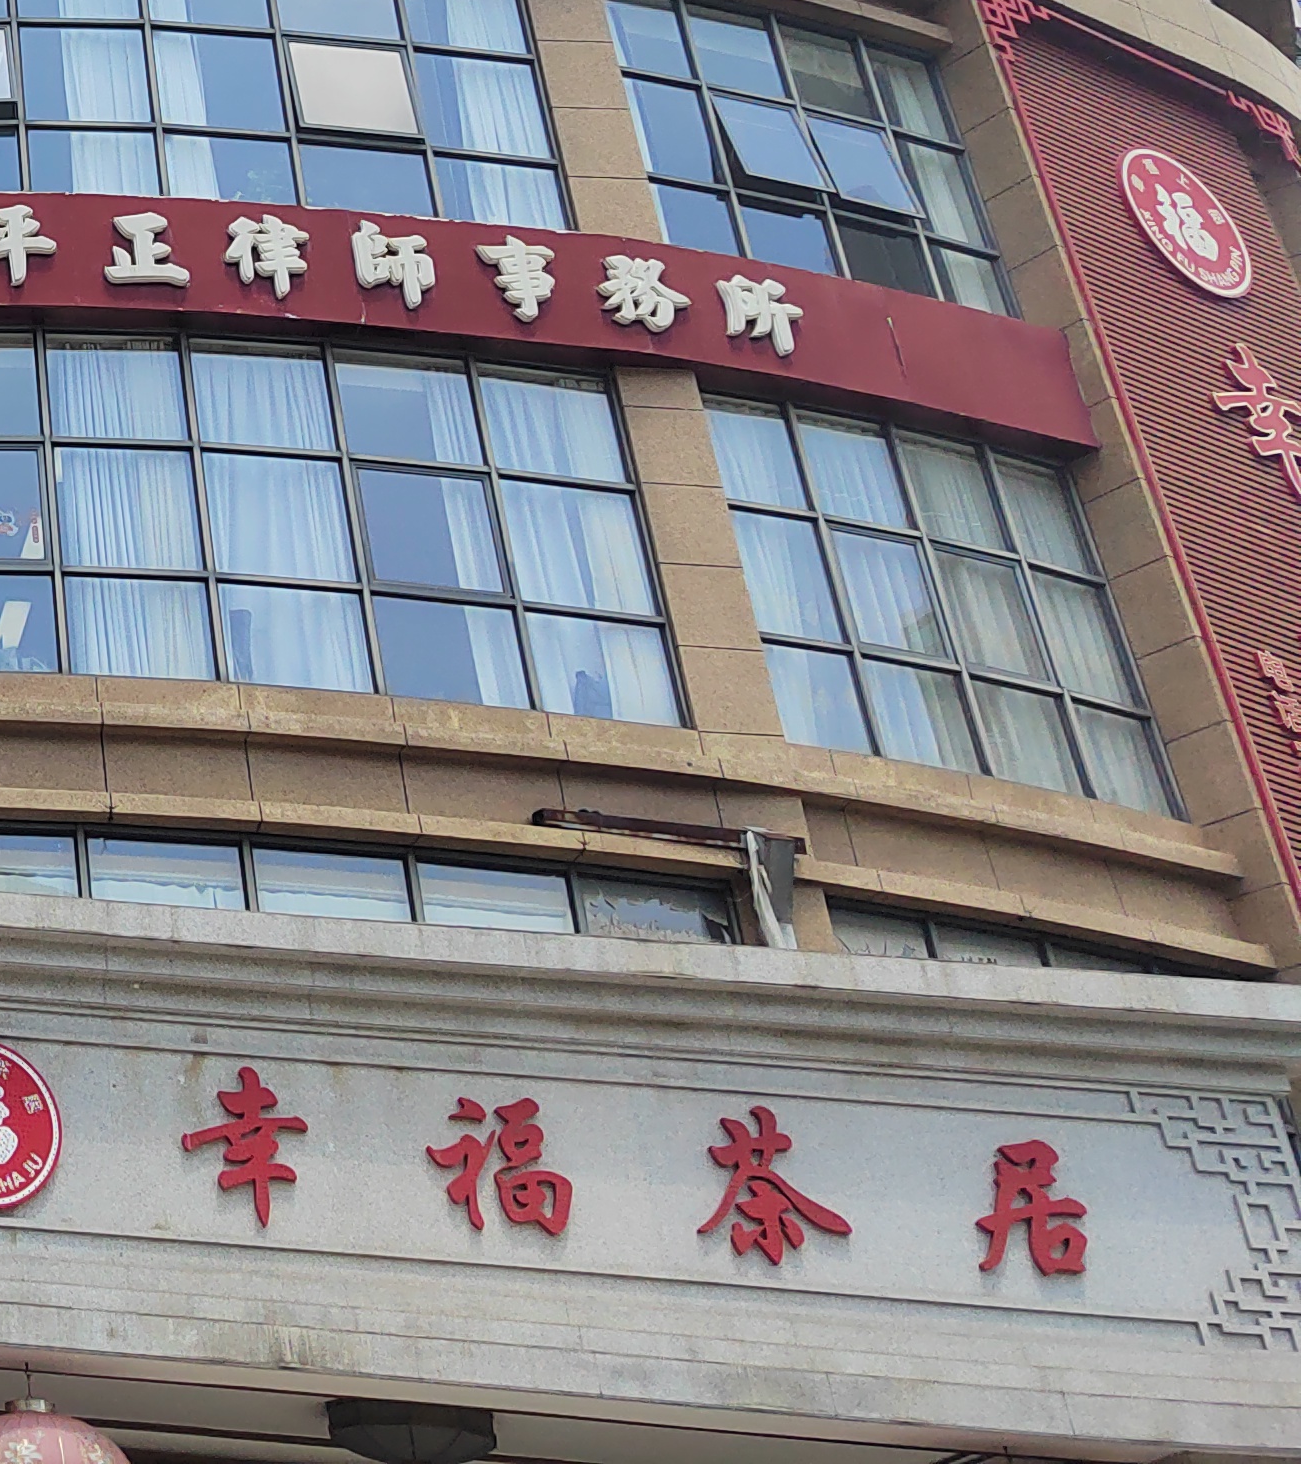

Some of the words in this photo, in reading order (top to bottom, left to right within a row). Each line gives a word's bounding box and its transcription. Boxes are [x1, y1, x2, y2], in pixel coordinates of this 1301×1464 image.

[1155, 183, 1219, 262] 福
[182, 1066, 1087, 1276] 幸福茶居
